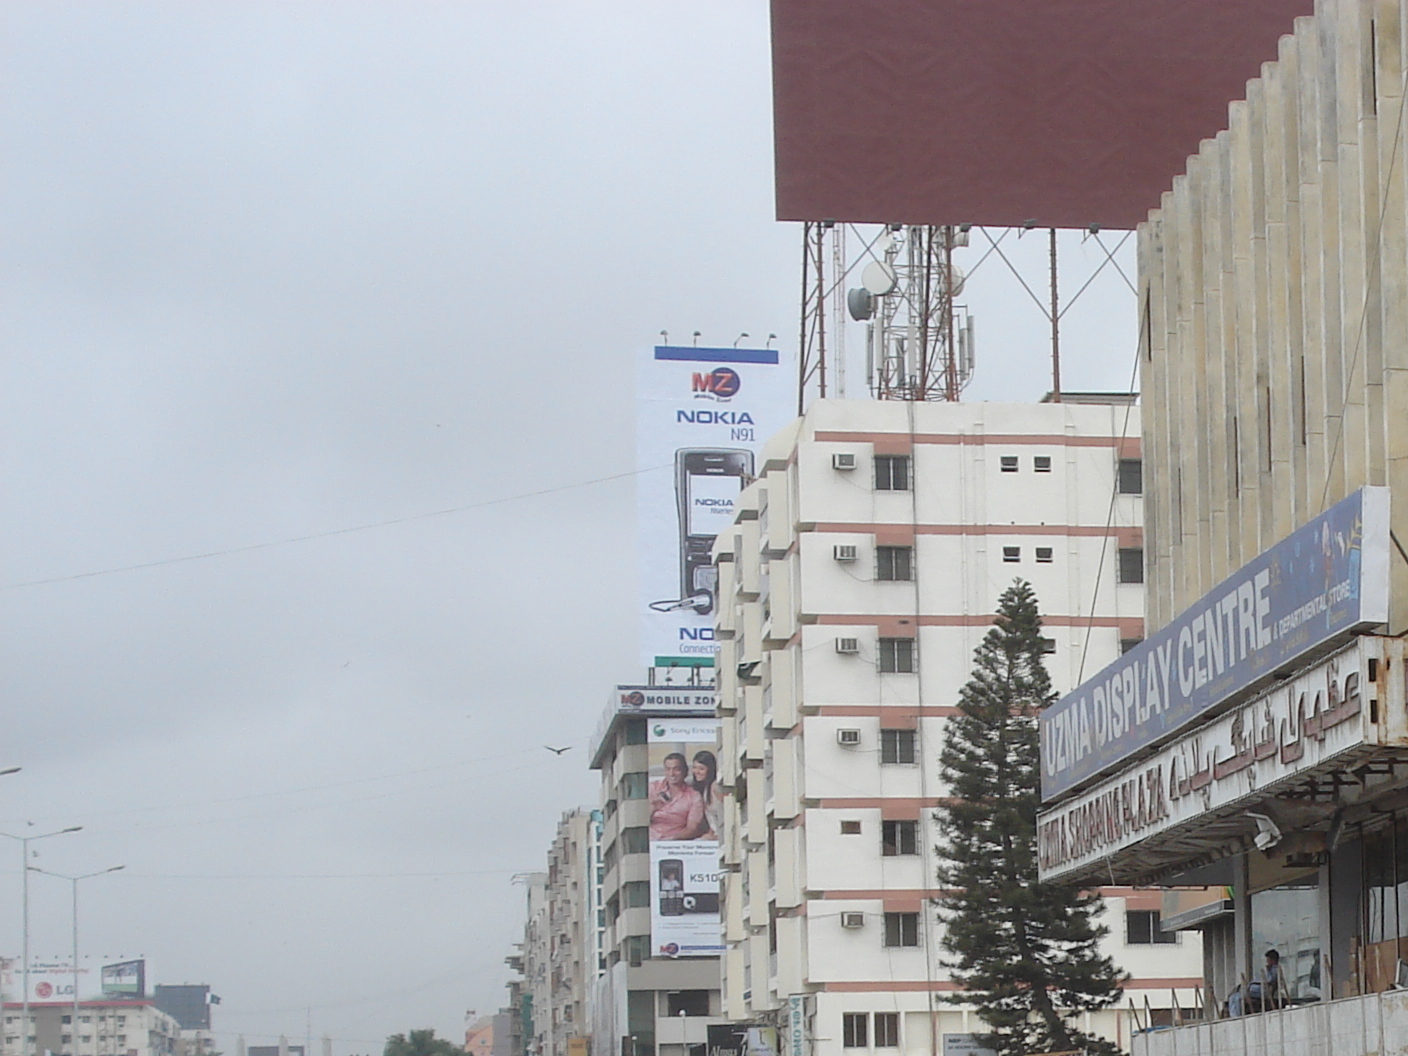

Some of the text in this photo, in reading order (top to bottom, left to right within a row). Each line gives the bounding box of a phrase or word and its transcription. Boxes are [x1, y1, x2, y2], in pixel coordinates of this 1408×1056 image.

[692, 372, 734, 392] MZ
[677, 410, 755, 426] NOKIA
[731, 427, 756, 442] N91
[695, 498, 734, 507] NOKIA
[1045, 567, 1274, 777] UZMA DISPLAY CENTRE
[647, 696, 690, 705] MOBILE
[56, 985, 74, 995] LG
